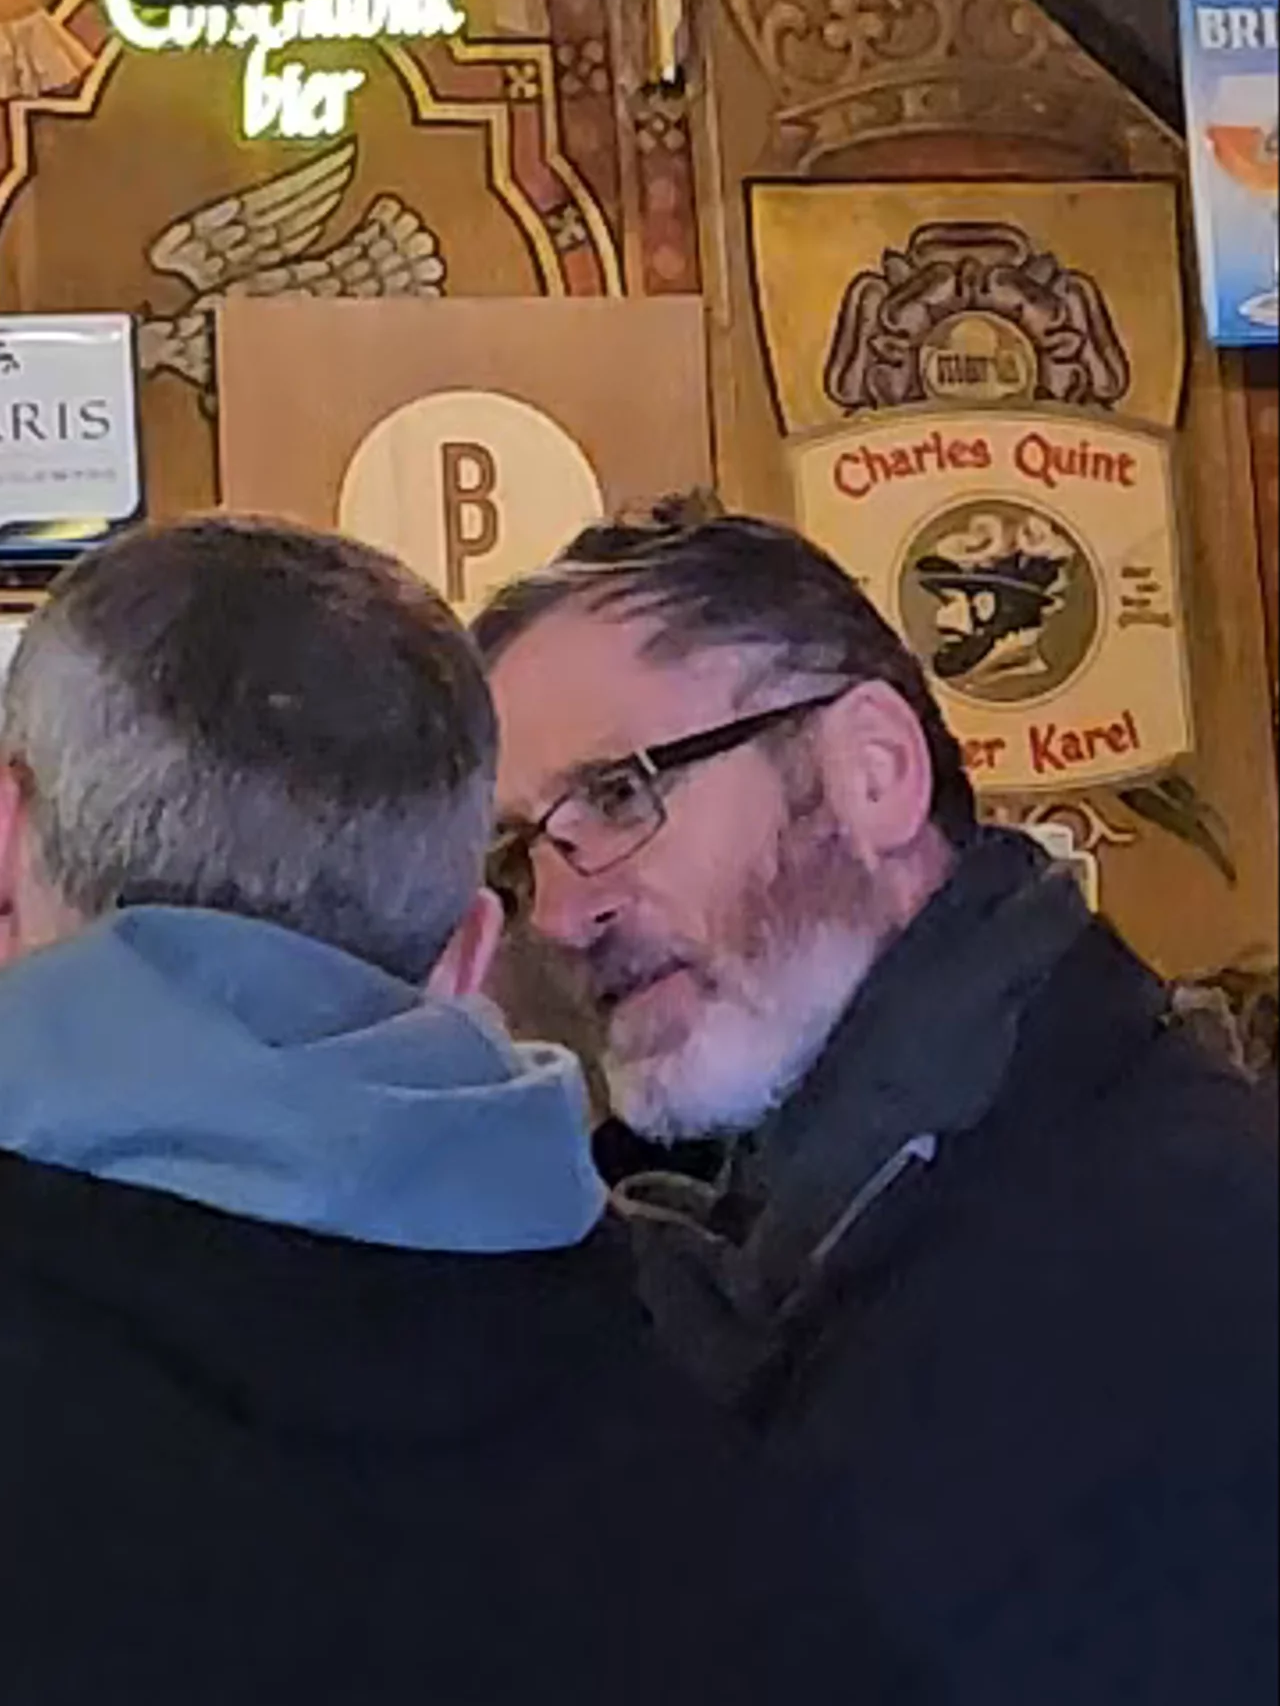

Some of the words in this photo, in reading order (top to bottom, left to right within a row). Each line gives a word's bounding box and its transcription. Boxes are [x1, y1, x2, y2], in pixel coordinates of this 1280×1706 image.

[242, 40, 365, 138] bier
[833, 431, 992, 497] Charles
[1014, 432, 1137, 488] Quint
[1029, 710, 1140, 774] Karel
